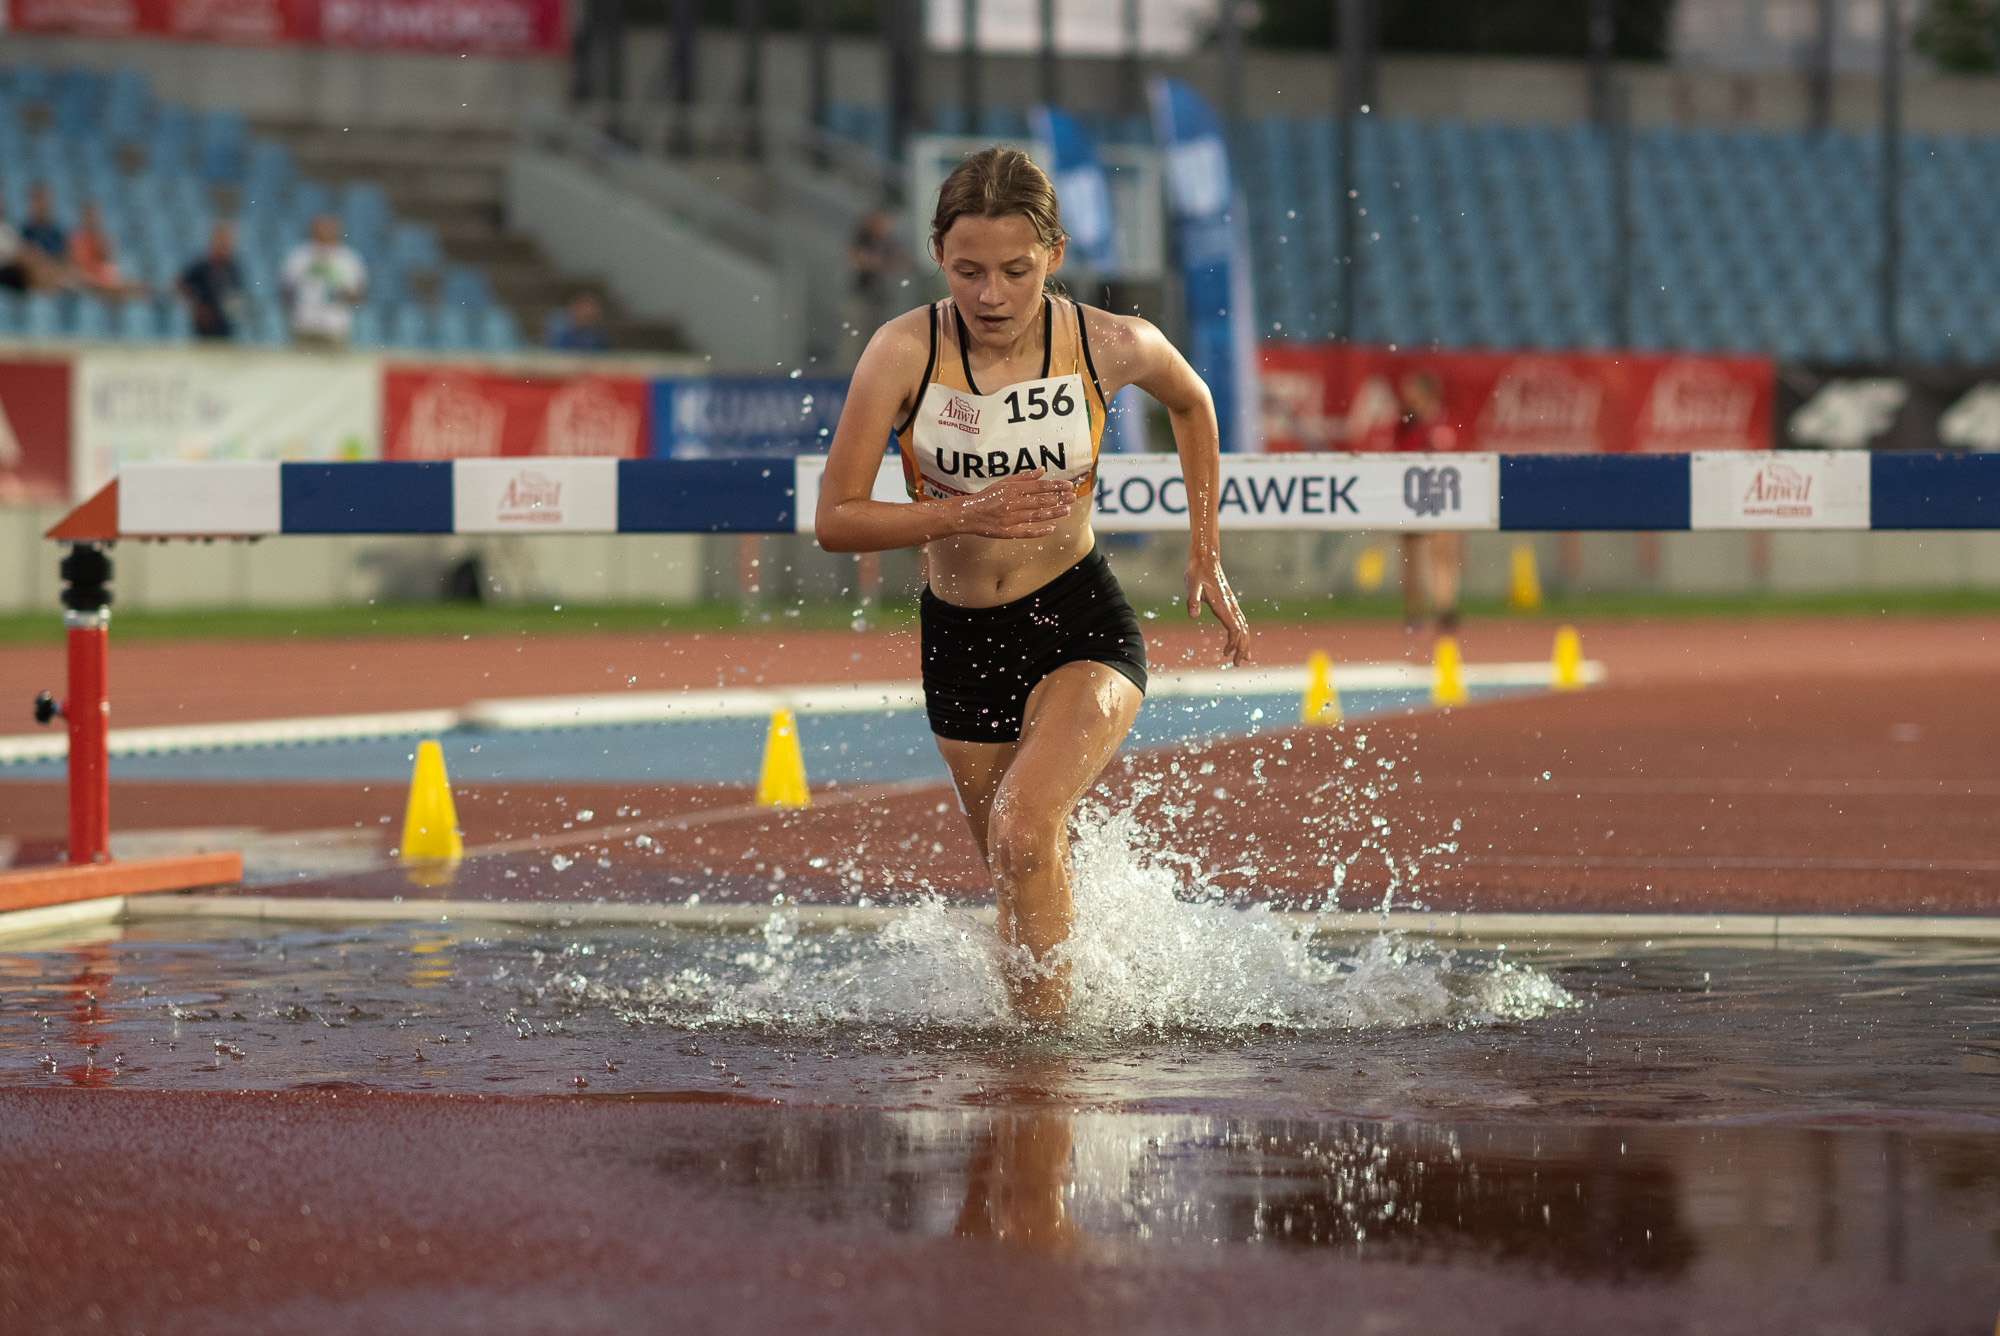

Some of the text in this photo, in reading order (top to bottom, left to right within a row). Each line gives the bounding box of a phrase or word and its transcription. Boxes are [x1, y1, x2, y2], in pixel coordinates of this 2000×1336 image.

[939, 398, 981, 425] Anwil
[1003, 383, 1075, 424] 156
[938, 419, 958, 429] GRUPA
[936, 442, 1067, 479] URBAN
[1094, 476, 1360, 514] ŁOCAWEK
